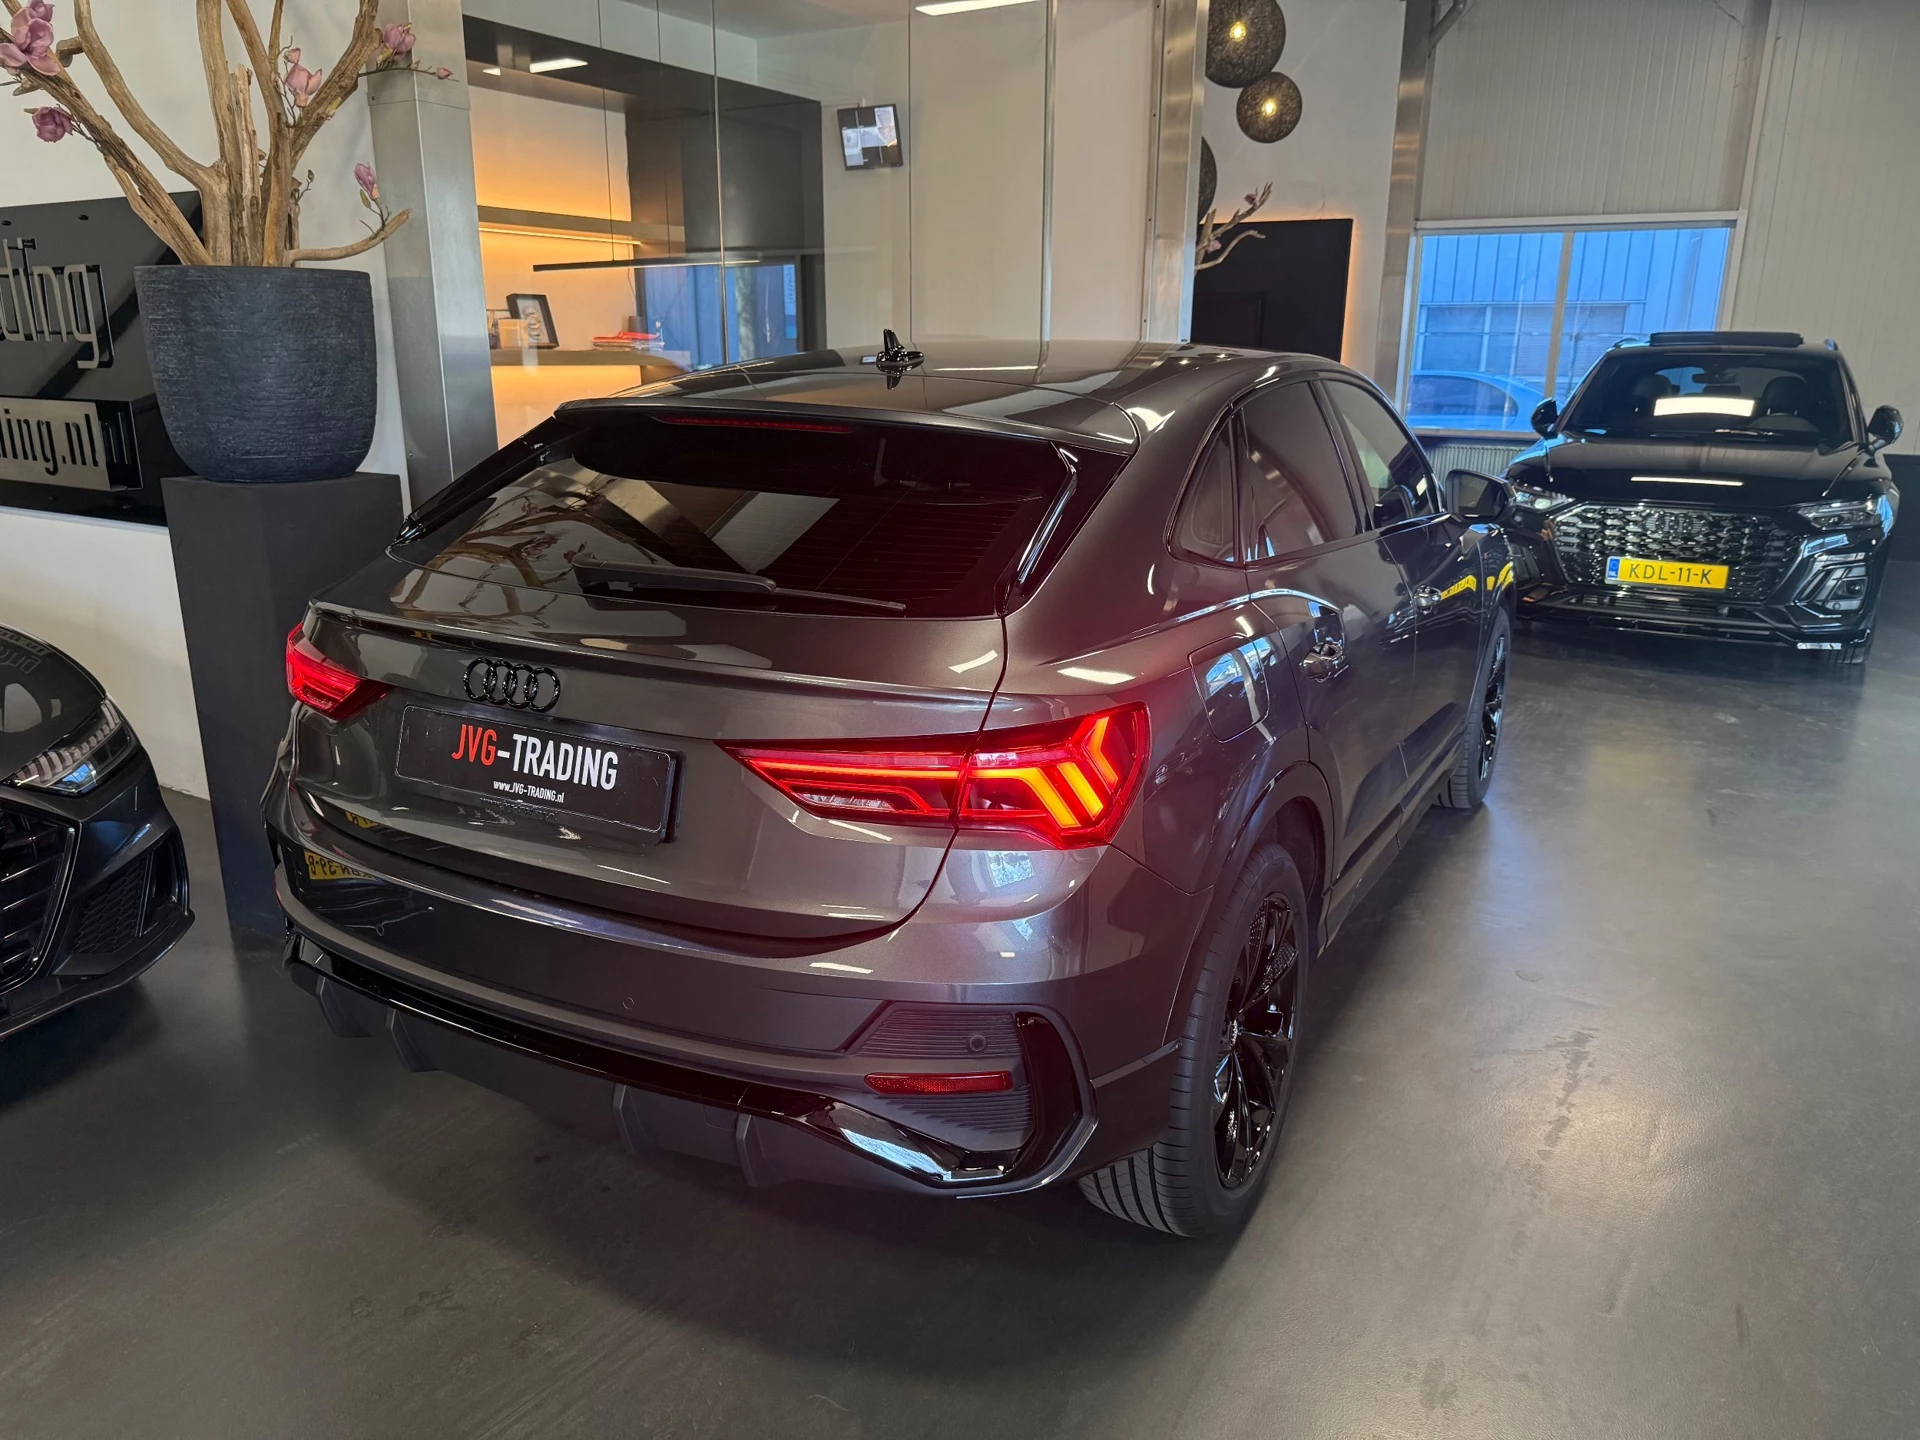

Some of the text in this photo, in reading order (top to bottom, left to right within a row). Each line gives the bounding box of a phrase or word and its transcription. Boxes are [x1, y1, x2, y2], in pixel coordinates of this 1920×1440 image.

[1629, 563, 1712, 584] KDL-11-K
[451, 723, 619, 791] JVG-TRADING
[493, 780, 565, 803] www.JVG-TRADING.nl
